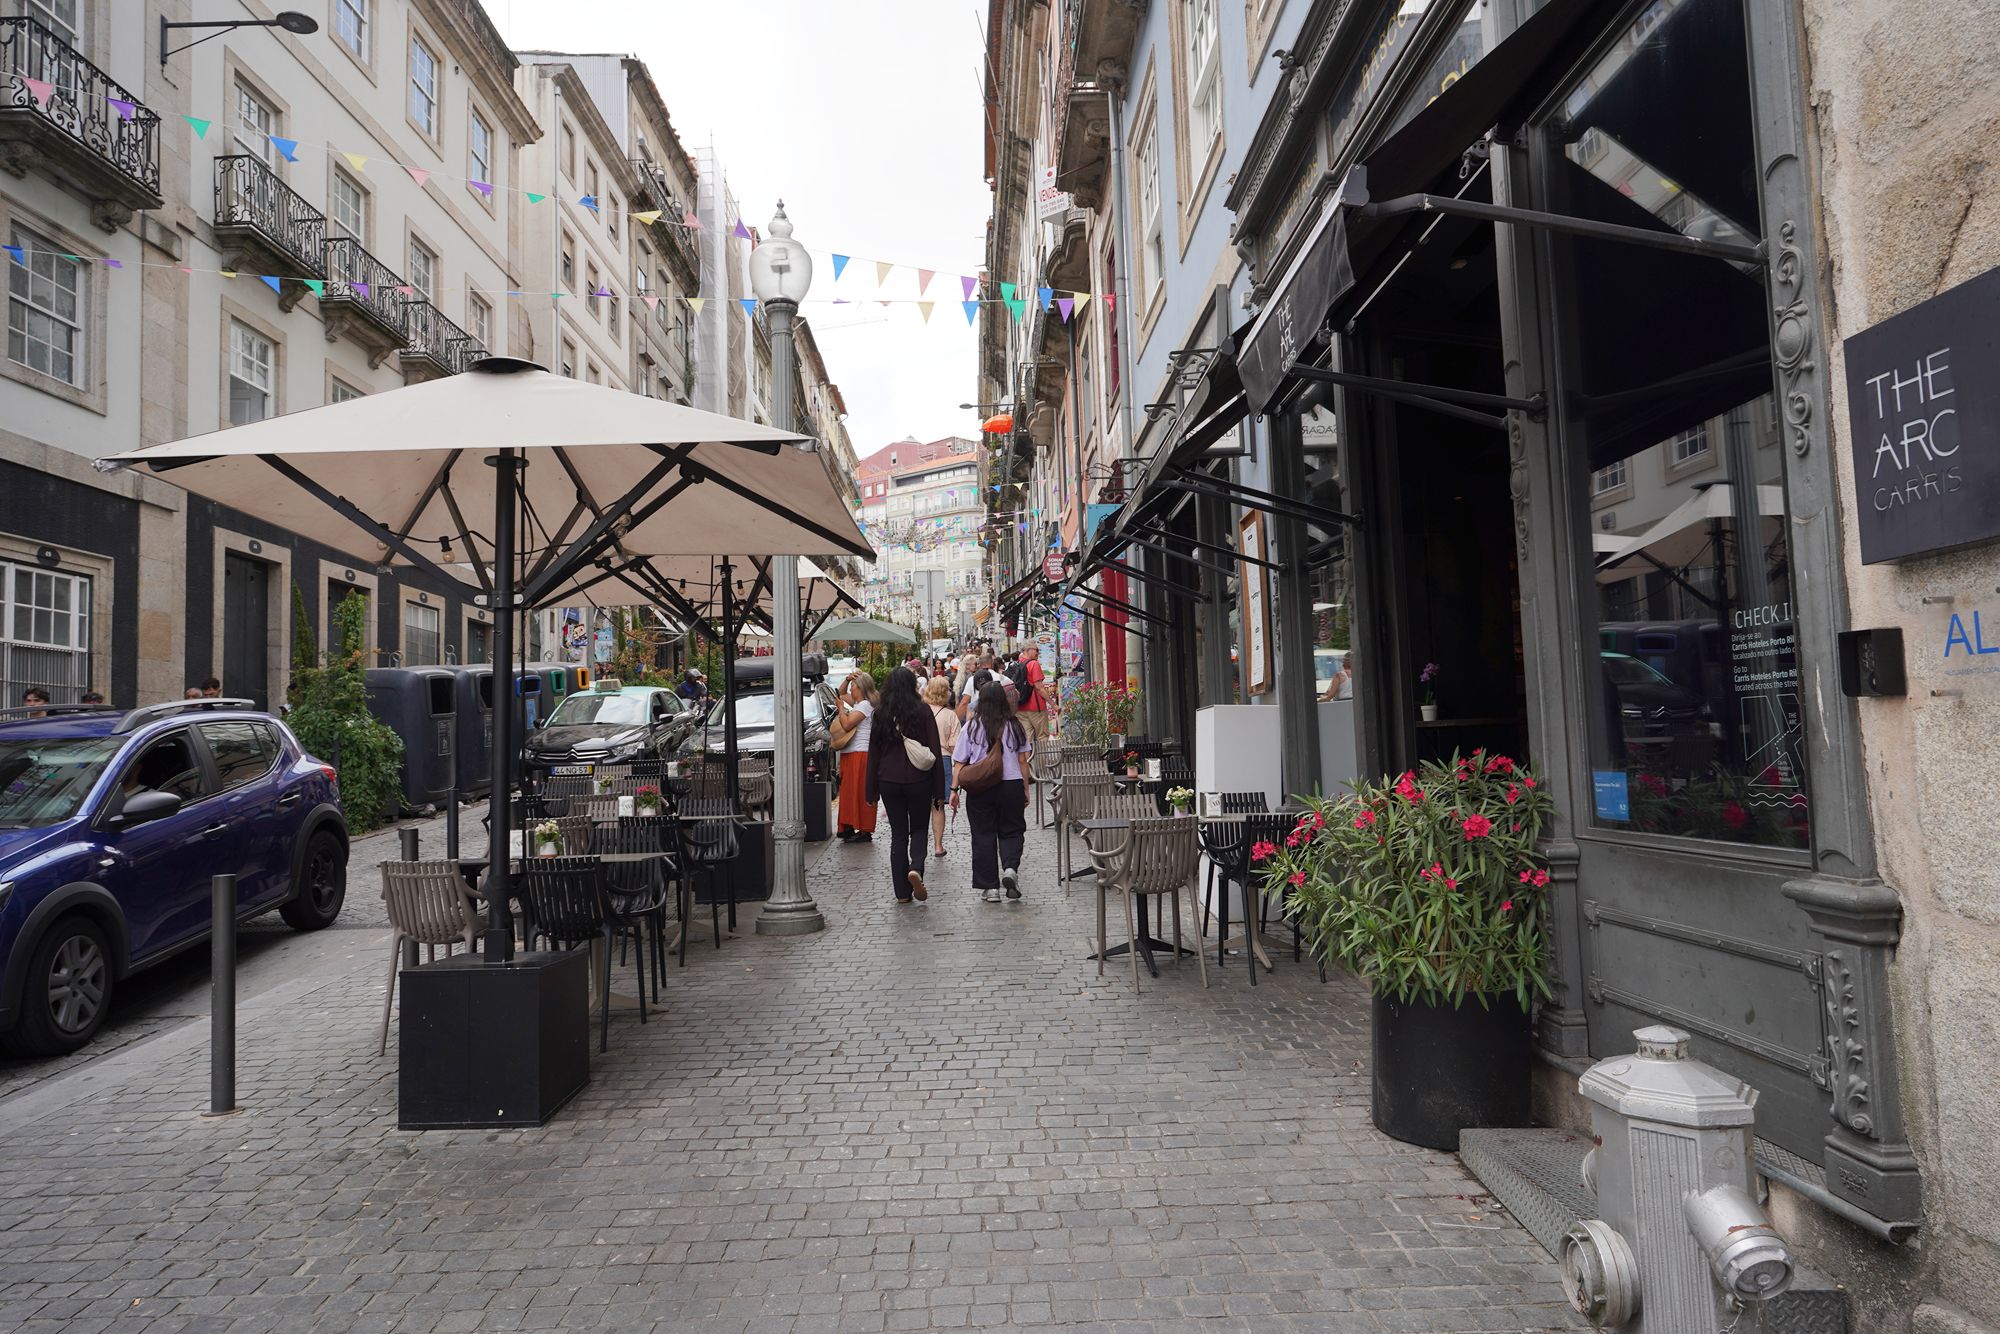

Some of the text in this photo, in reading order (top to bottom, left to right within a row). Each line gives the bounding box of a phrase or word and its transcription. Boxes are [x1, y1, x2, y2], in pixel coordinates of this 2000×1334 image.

[1276, 295, 1291, 331] THE
[1280, 321, 1295, 358] ARC
[1865, 347, 1955, 419] THE
[1872, 409, 1960, 479] ARC
[1873, 466, 1962, 511] CARRIS
[1735, 604, 1779, 629] CHECK
[1944, 610, 2000, 657] AL
[1732, 650, 1757, 660] localizado
[1764, 648, 1779, 656] outro
[1779, 646, 1791, 654] lado
[1748, 640, 1769, 650] Hoteles
[1770, 637, 1786, 646] Porto
[1735, 682, 1754, 691] located
[1755, 681, 1772, 690] across
[1773, 680, 1783, 689] the
[1750, 671, 1772, 681] Hoteles
[1772, 670, 1788, 679] Porto
